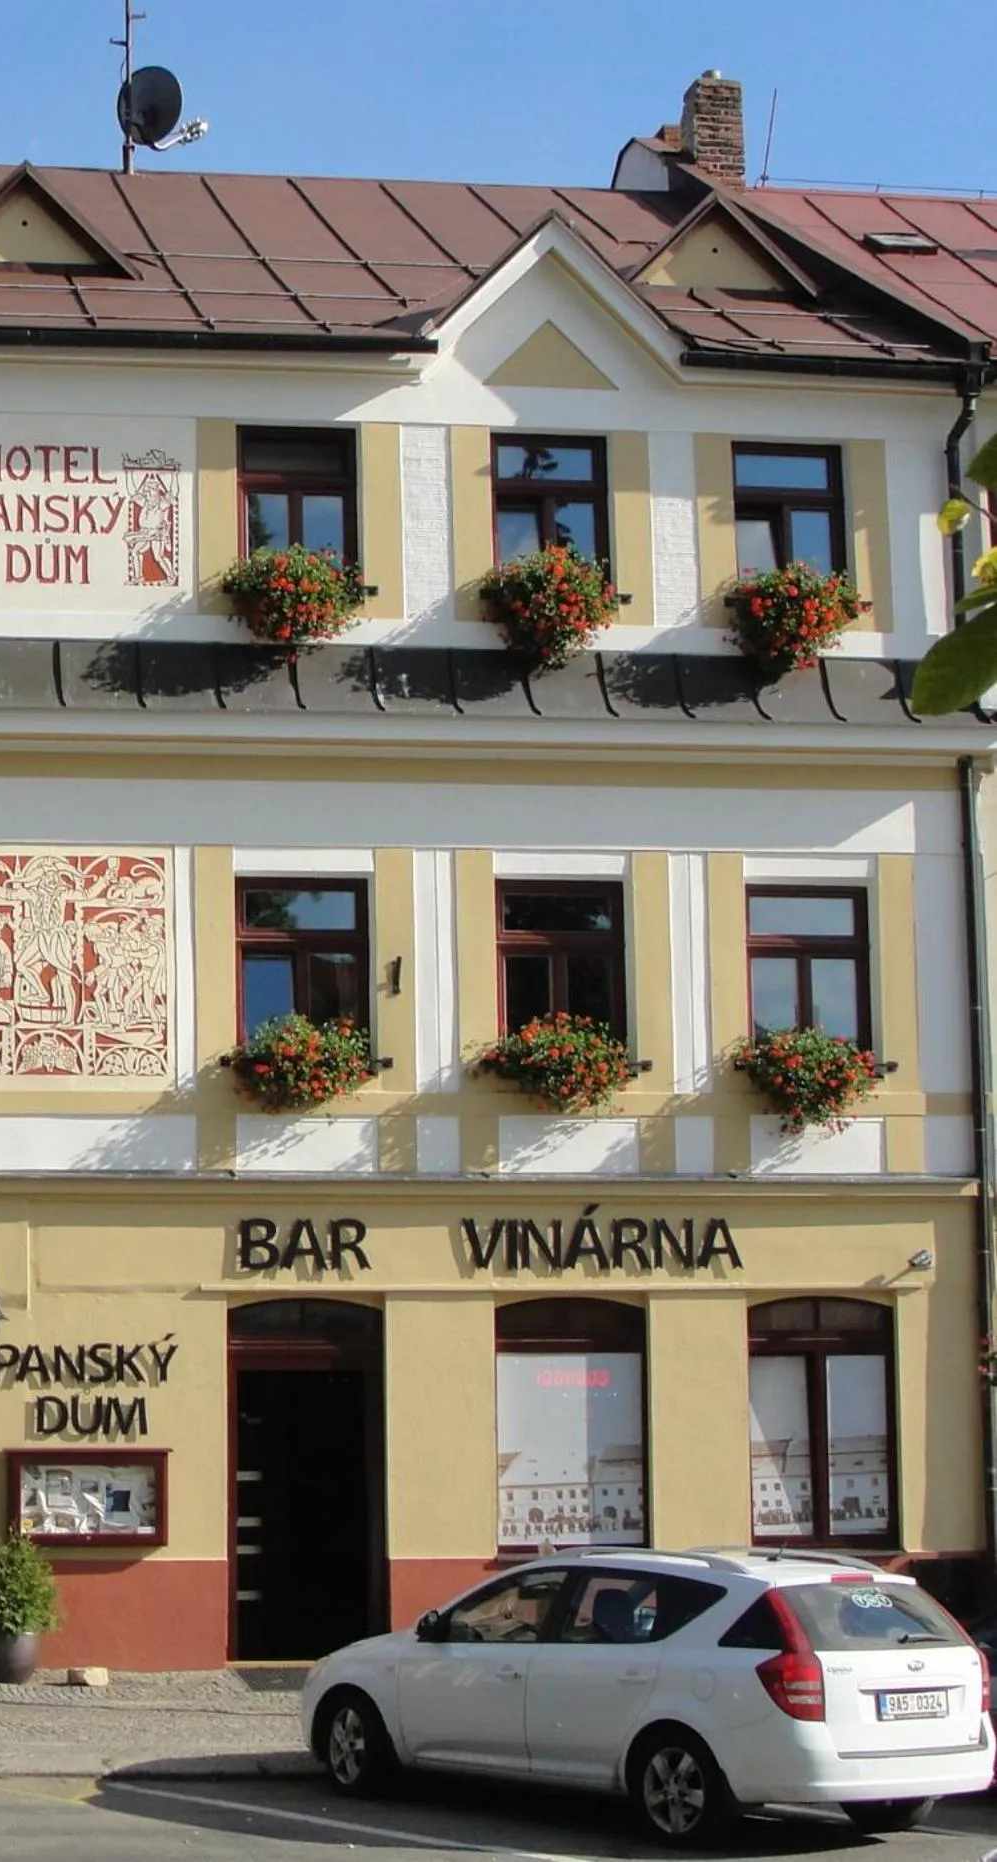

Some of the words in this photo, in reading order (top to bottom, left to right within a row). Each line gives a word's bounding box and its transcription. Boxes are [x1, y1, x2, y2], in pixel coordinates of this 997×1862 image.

[5, 537, 90, 585] DŮM
[239, 1217, 372, 1272] BAR
[461, 1202, 744, 1270] VINÁRNA
[888, 1696, 910, 1712] 9A5
[916, 1694, 943, 1711] 0324
